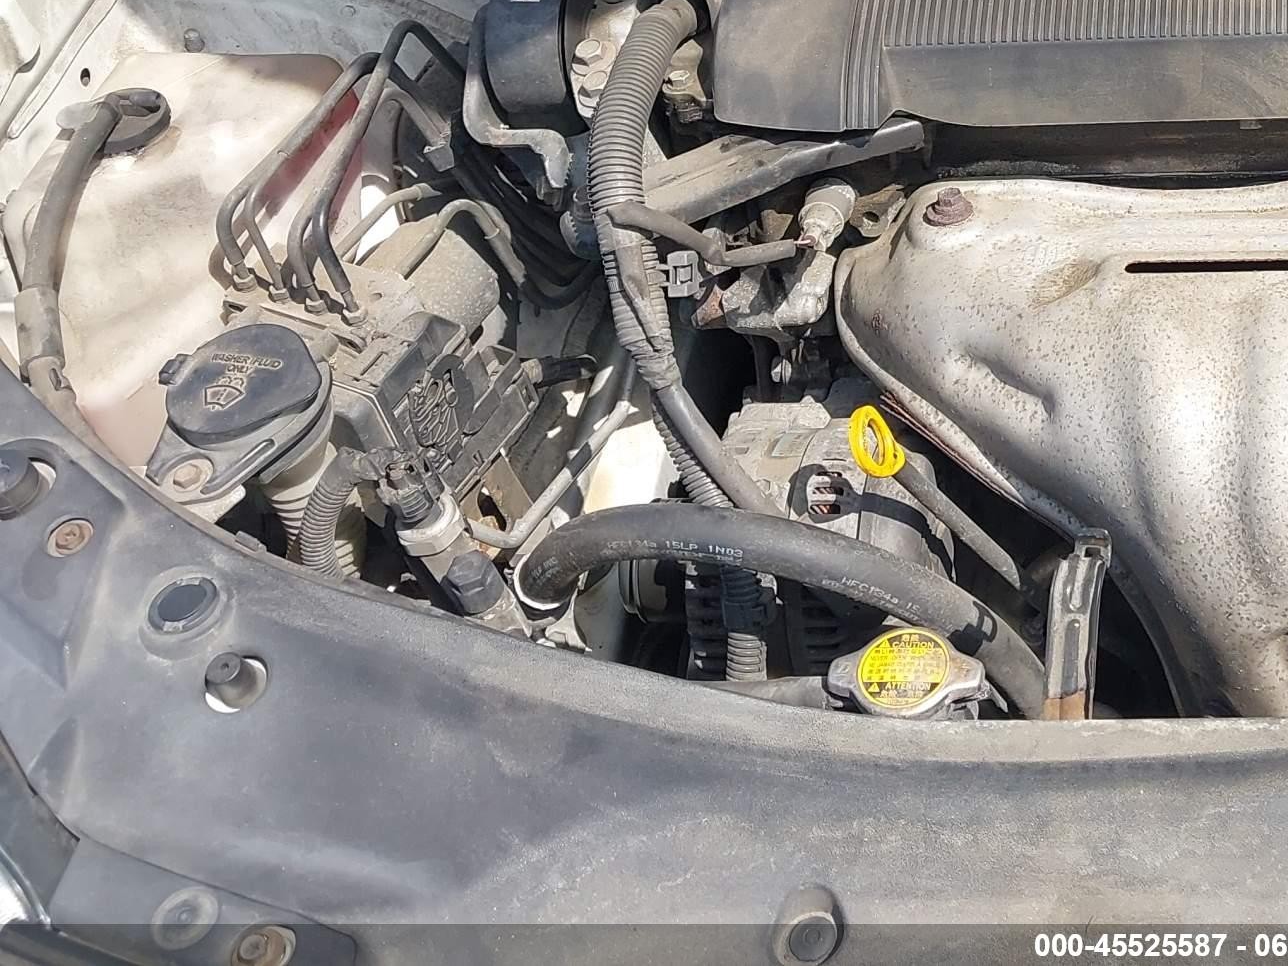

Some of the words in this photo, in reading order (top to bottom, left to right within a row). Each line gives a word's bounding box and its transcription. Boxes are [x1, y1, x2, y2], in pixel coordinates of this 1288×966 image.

[211, 353, 250, 364] WASHER
[251, 357, 282, 369] FLUID
[226, 364, 250, 374] ONLY
[892, 641, 935, 649] CAUTION
[884, 681, 932, 691] ATTENTION
